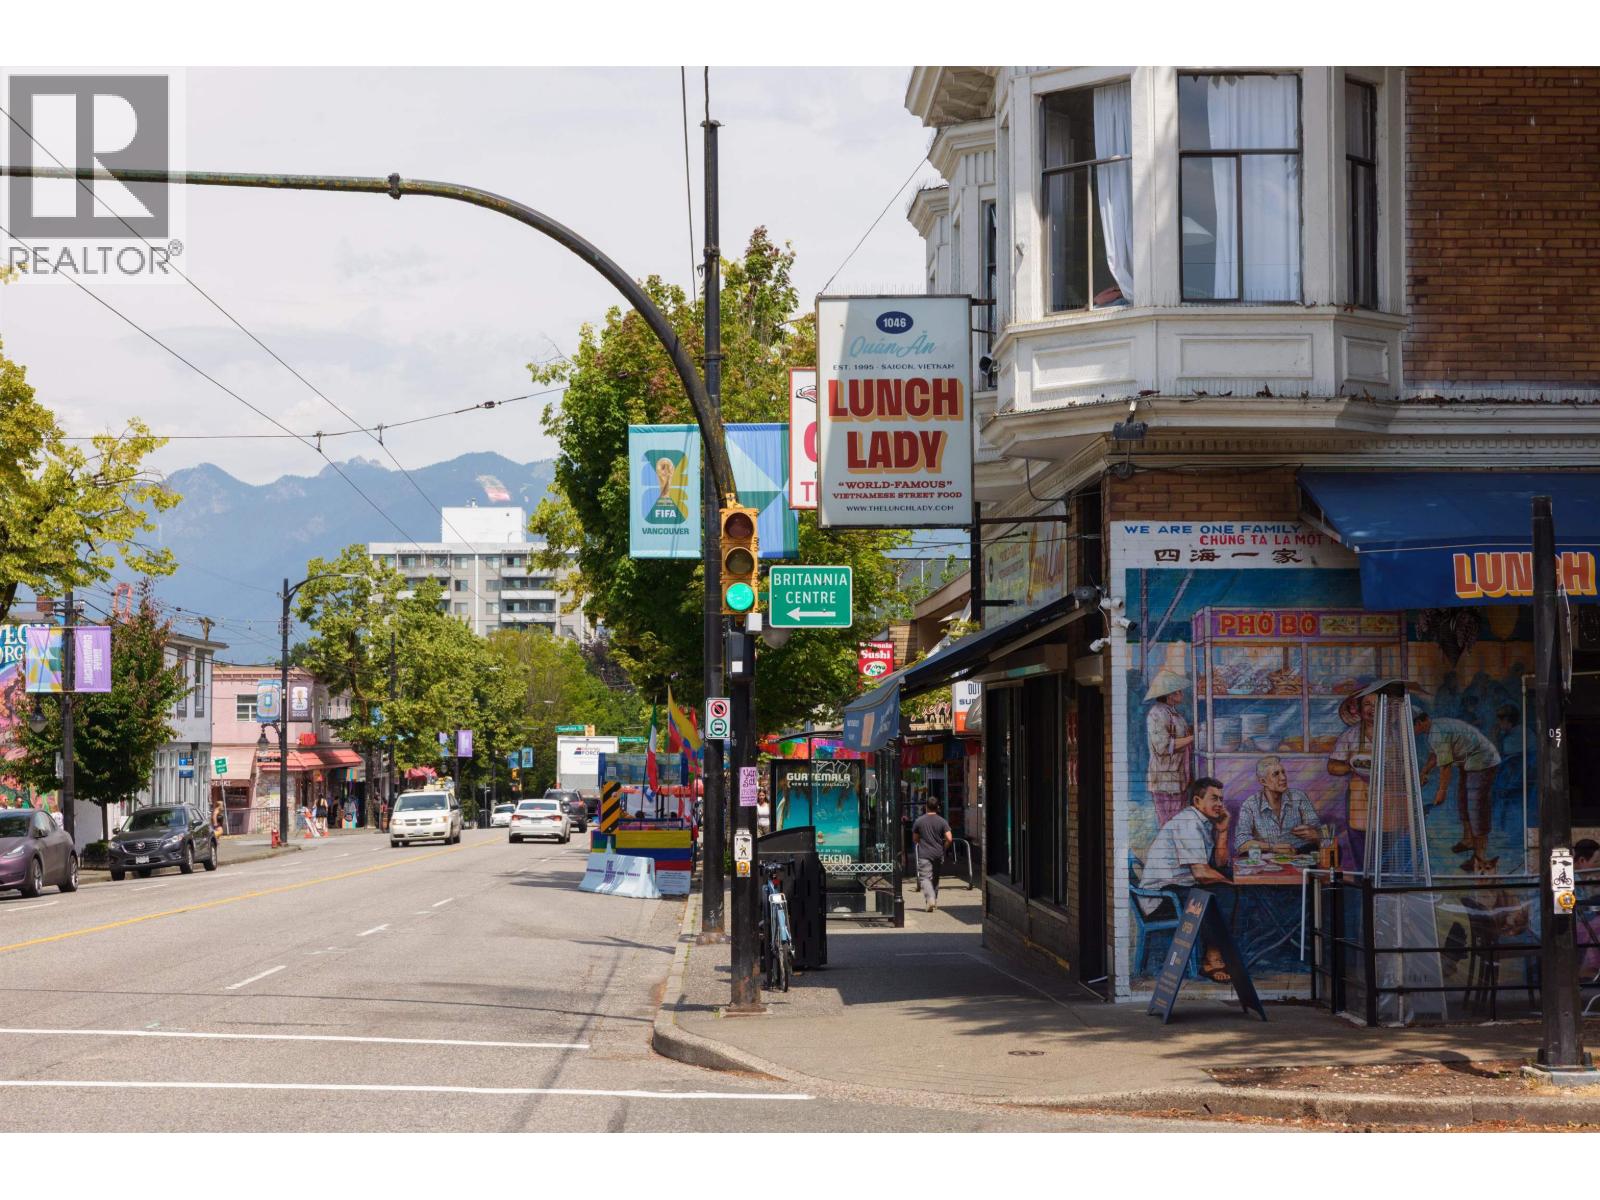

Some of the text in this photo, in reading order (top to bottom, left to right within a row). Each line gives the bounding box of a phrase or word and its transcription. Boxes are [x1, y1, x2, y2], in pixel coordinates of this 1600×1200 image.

[883, 317, 907, 328] 1046
[828, 377, 964, 422] LUNCH
[847, 430, 948, 474] LADY
[832, 492, 896, 500] VIETNAMESE
[655, 509, 677, 518] FIFA
[641, 527, 690, 535] VANCOUVER
[1124, 524, 1301, 534] WE ARE ONE FAMILY
[1154, 547, 1303, 564] 四海一家
[773, 573, 848, 586] BRITANNIA
[785, 591, 837, 604] CENTRE
[860, 649, 891, 659] Sushi
